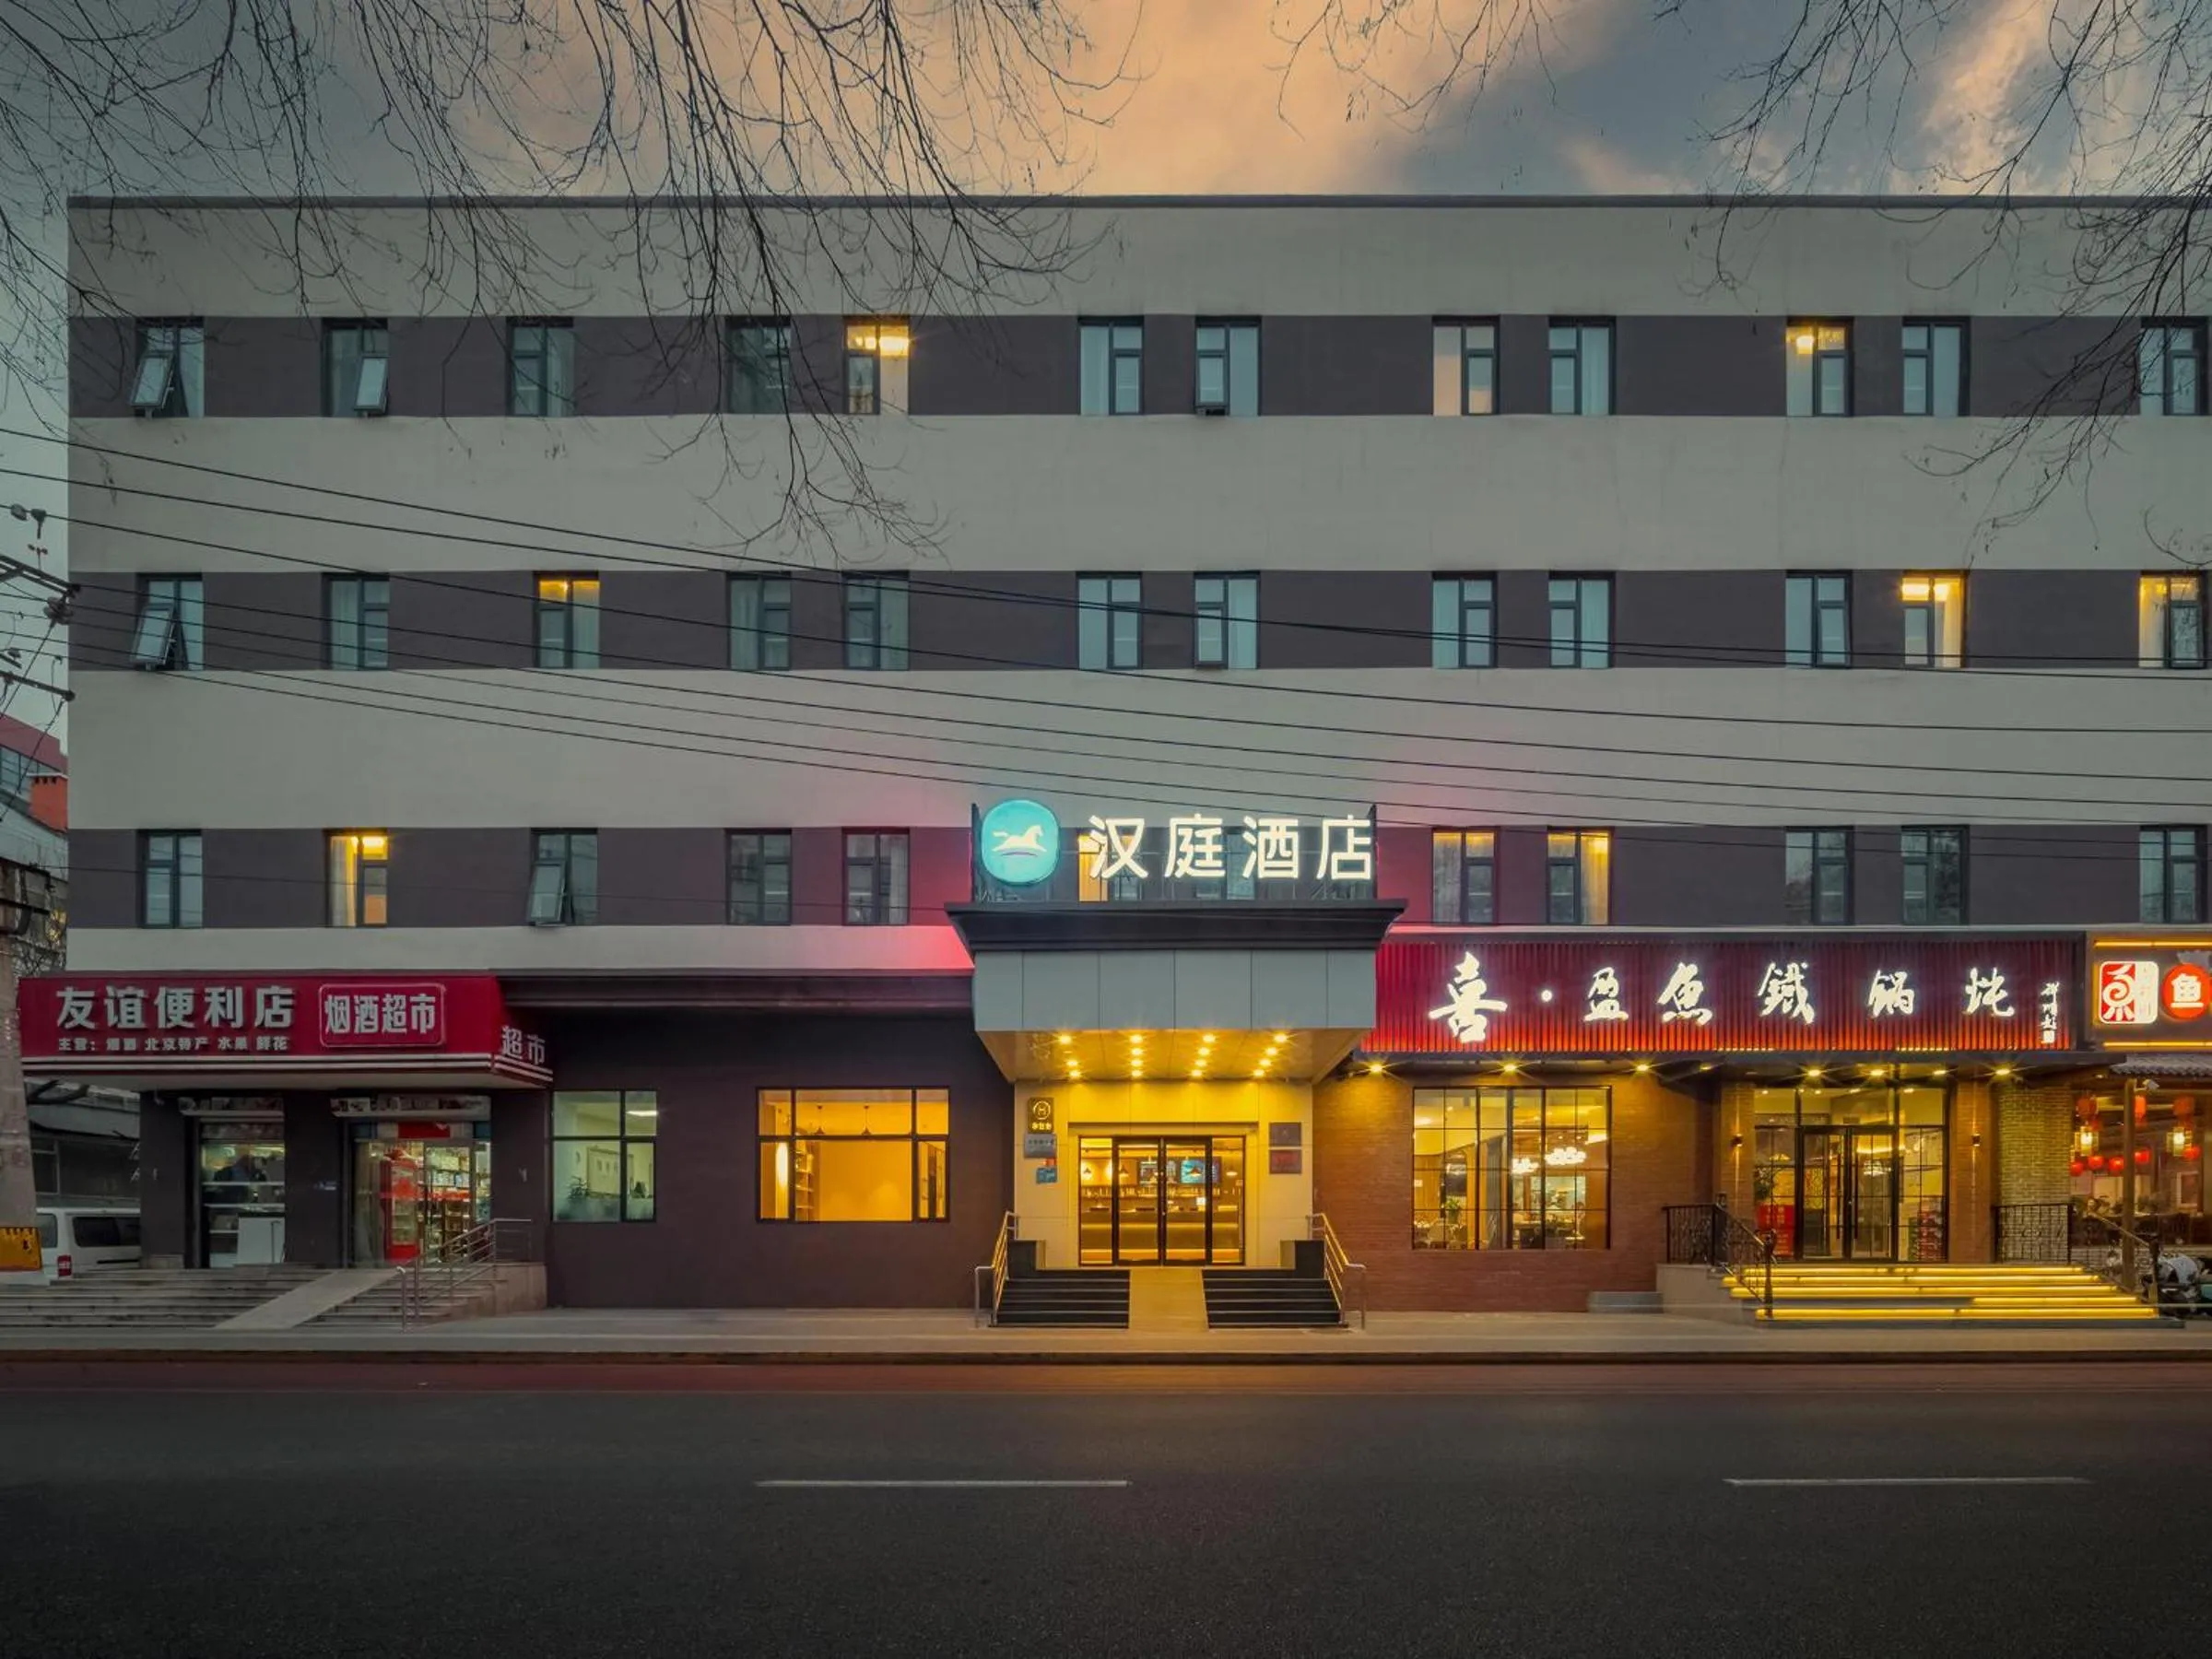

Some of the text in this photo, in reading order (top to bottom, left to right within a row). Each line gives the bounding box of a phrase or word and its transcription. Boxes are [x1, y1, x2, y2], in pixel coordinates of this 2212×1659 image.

[1088, 813, 1372, 879] 汉庭酒店
[55, 985, 296, 1030] 友谊便利店
[324, 993, 437, 1034] 烟酒超市
[500, 1025, 546, 1065] 超市
